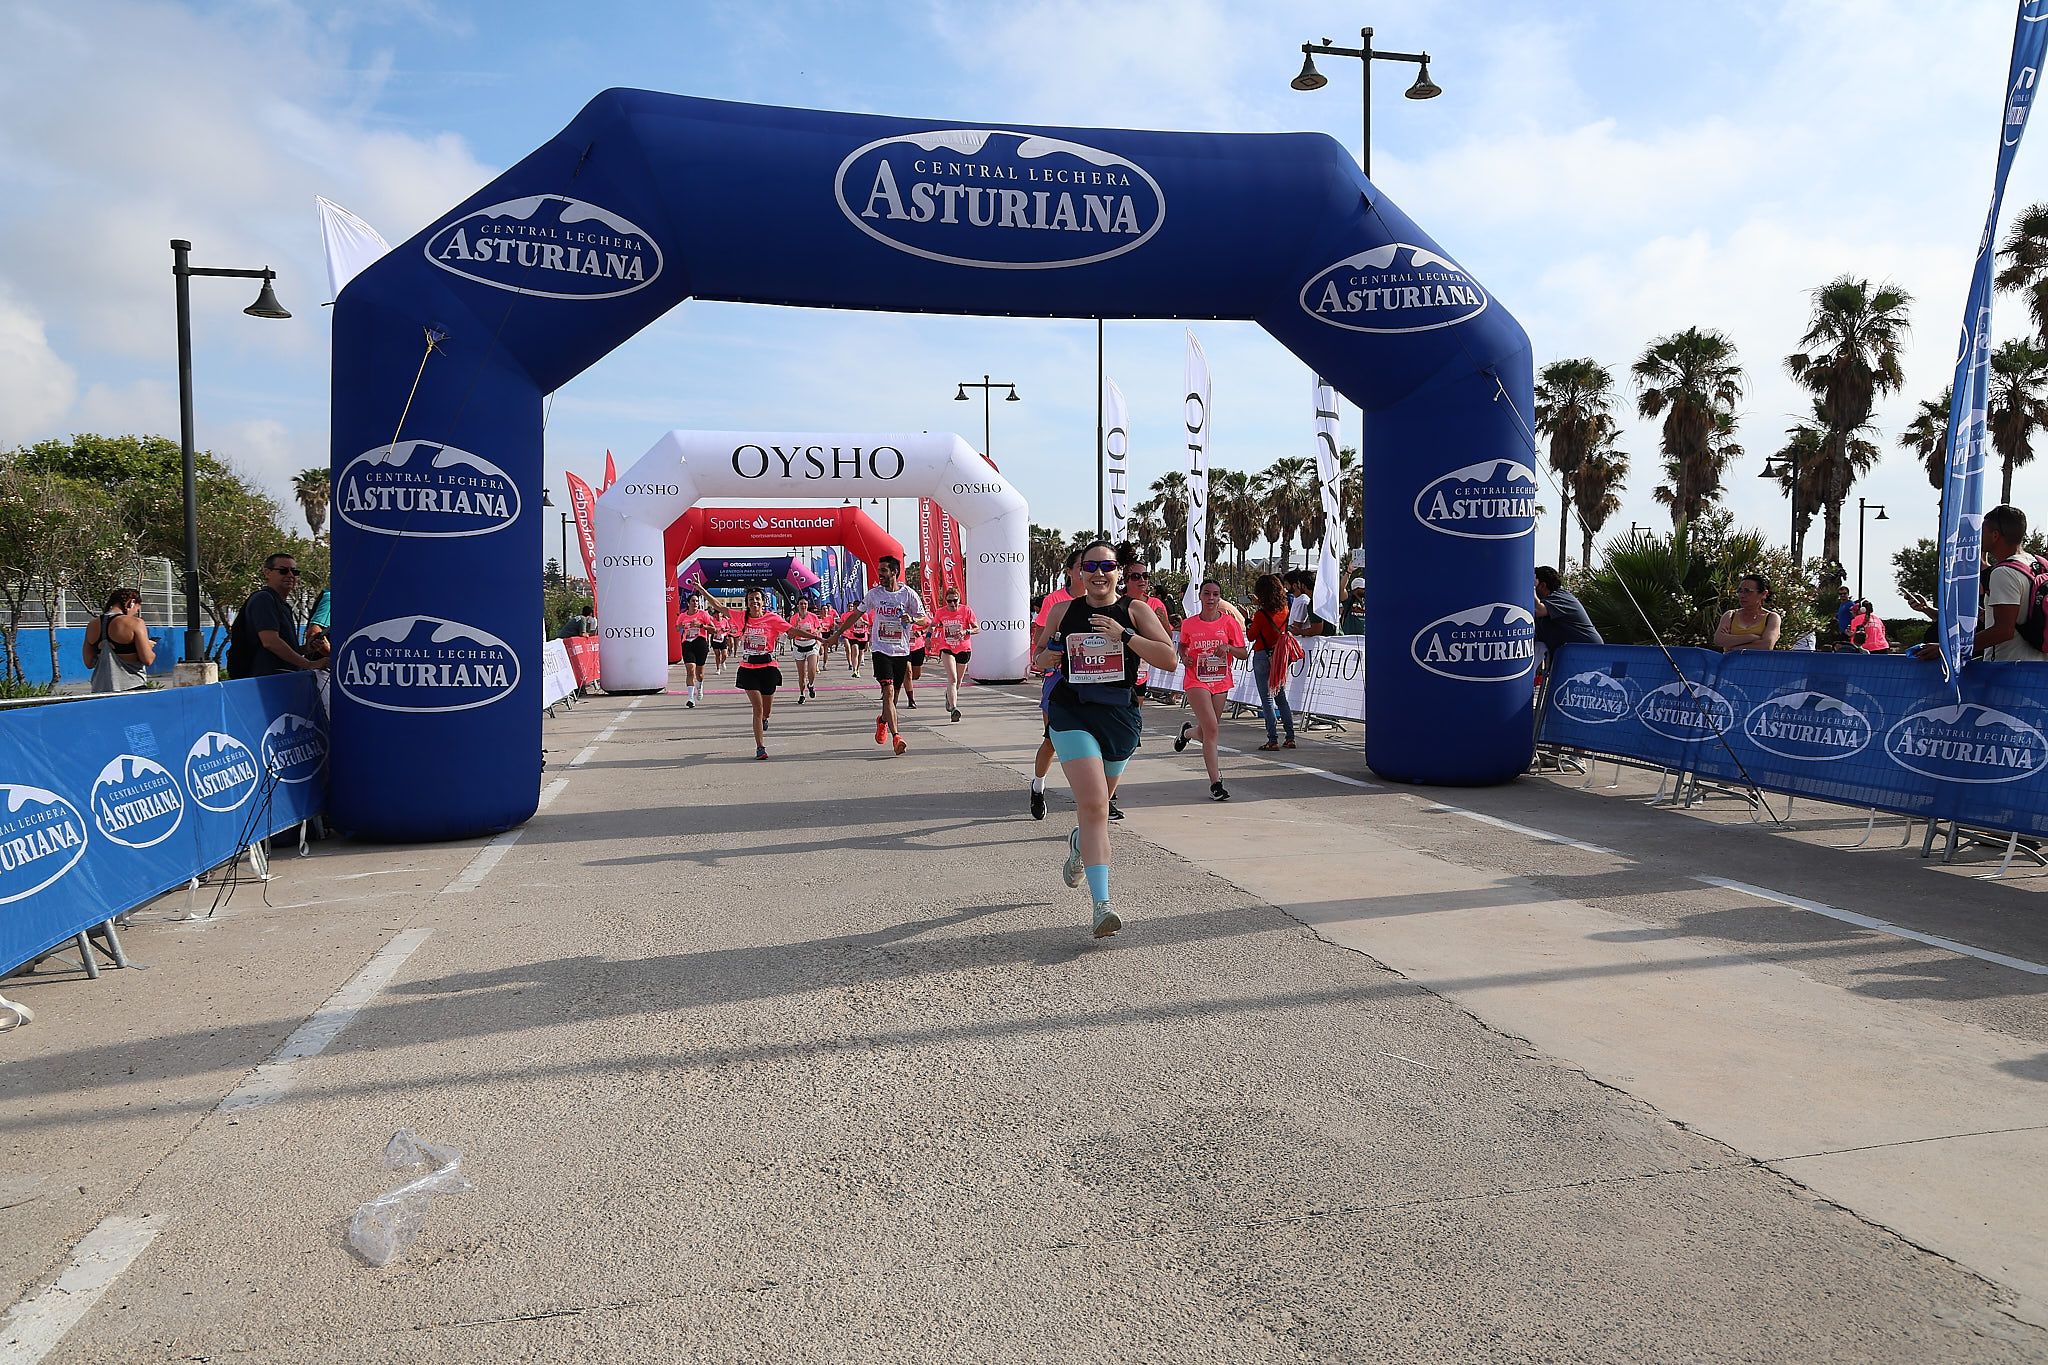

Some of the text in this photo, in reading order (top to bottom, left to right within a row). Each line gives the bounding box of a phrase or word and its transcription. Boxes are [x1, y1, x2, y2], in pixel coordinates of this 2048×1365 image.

[914, 160, 1130, 186] CENTRAL LECHERA
[861, 159, 1140, 234] ASTURIANA
[481, 224, 642, 251] CENTRAL LECHERA
[438, 227, 645, 282] ASTURIANA
[1350, 272, 1467, 286] CENTRAL LECHERA
[1315, 280, 1481, 313] ASTURIANA
[732, 444, 905, 480] OYSHO
[366, 472, 504, 490] CENTRAL LECHERA
[625, 484, 679, 496] OYSHO
[952, 482, 1002, 494] OYSHO
[344, 476, 510, 518] ASTURIANA
[1455, 487, 1507, 496] CENTRAL
[1426, 490, 1535, 520] ASTURIAN
[710, 517, 834, 532] Sports Santander
[603, 556, 654, 568] OYSHO
[980, 552, 1025, 564] OYSHO
[605, 626, 655, 639] OYSHO
[980, 620, 1025, 631] OYSHO
[1452, 630, 1504, 640] CENTRAL
[366, 648, 504, 660] CENTRAL LECHERA
[1194, 640, 1223, 649] CARRERA
[344, 650, 510, 688] ASTURIANA
[1085, 656, 1106, 664] 016
[1559, 687, 1622, 714] ASTURIANA
[1641, 698, 1724, 731] ASTURIANA
[1774, 711, 1859, 727] CENTRAL LECHERA
[1752, 712, 1858, 748] ASTURIANA
[1922, 727, 2033, 746] CENTRAL LECHERA
[1894, 726, 2033, 769] ASTURIANA
[109, 786, 140, 802] CENTRAL
[18, 806, 67, 829] LECHERA
[100, 788, 180, 833] ASTURIANA
[0, 820, 82, 872] URIANA
